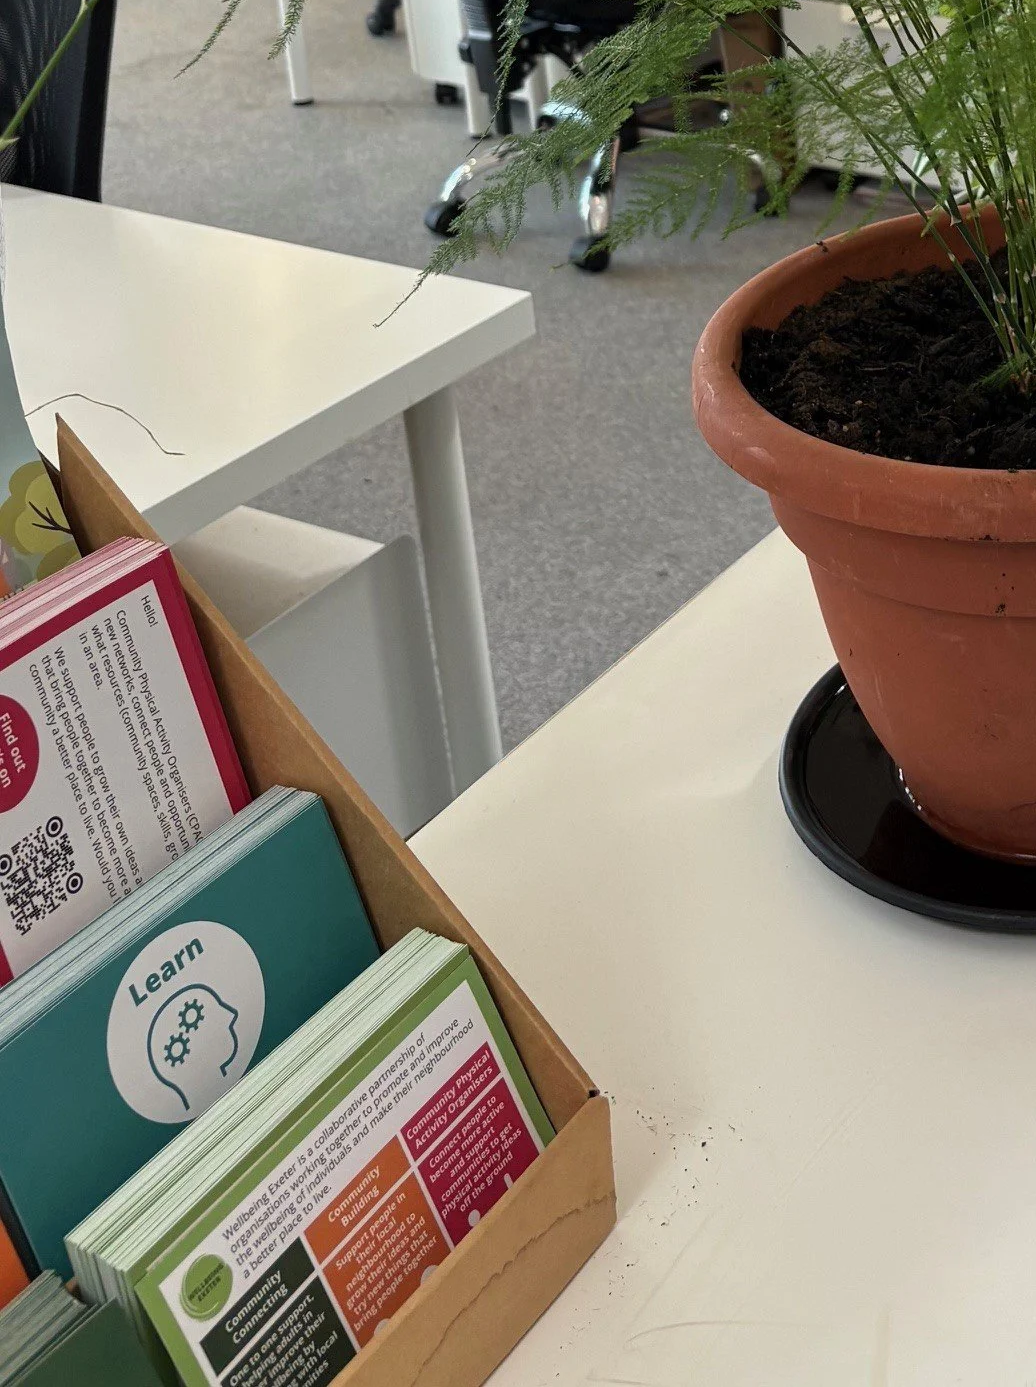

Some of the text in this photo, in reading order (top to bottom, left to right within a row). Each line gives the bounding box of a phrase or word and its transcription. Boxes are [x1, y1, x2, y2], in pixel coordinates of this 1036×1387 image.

[140, 594, 159, 628] Hello!
[41, 654, 56, 681] that
[54, 646, 66, 667] We
[78, 631, 103, 691] in an area.
[29, 663, 57, 726] community
[50, 678, 67, 712] bring
[60, 667, 83, 713] support
[103, 617, 118, 641] new
[112, 642, 135, 696] networks,
[131, 695, 152, 740] connect
[143, 739, 165, 777] people
[159, 777, 175, 799] and
[116, 609, 144, 672] Community
[137, 672, 161, 717] Physical
[152, 717, 172, 756] Activity
[167, 755, 192, 814] Organisers
[0, 712, 26, 773] Find out
[51, 727, 60, 736] a
[55, 734, 73, 770] better
[58, 710, 80, 750] people
[74, 712, 96, 752] people
[91, 624, 107, 654] what
[101, 653, 126, 708] resources
[118, 706, 148, 771] (community
[142, 771, 161, 813] spaces,
[156, 811, 172, 843] skills,
[75, 749, 98, 796] together
[90, 750, 100, 765] to
[92, 764, 111, 793] grow
[64, 771, 83, 803] place
[78, 801, 88, 816] to
[91, 797, 101, 811] to
[105, 793, 121, 820] their
[83, 814, 95, 840] live.
[96, 809, 118, 857] become
[115, 821, 129, 847] own
[91, 837, 112, 876] Would
[112, 856, 129, 888] more
[124, 844, 140, 877] ideas
[102, 875, 118, 899] you
[128, 938, 204, 1007] Learn
[406, 1049, 490, 1140] Community Physical
[415, 1065, 493, 1150] Activity Organisers
[222, 1031, 425, 1241] Wellbeing Exeter is a collaborative partnership of
[230, 1018, 459, 1254] organisations working together to promote and improve
[235, 1018, 474, 1267] the wellbeing of individuals and make their neighbourhood
[429, 1096, 497, 1169] Connect people to
[429, 1101, 505, 1184] become more active
[449, 1126, 495, 1178] and support
[441, 1122, 513, 1202] communities to get
[441, 1128, 522, 1220] physical activity ideas
[459, 1150, 514, 1212] off the ground
[328, 1165, 380, 1223] Community
[340, 1185, 380, 1227] Building
[243, 1185, 332, 1280] a better place to live.
[335, 1192, 406, 1271] Support people in
[345, 1212, 416, 1292] neighbourhood to
[353, 1216, 397, 1264] their local
[187, 1262, 224, 1302] WELLBEING
[346, 1215, 426, 1311] grow their ideas and
[353, 1230, 428, 1316] try new things that
[353, 1235, 437, 1332] bring people together
[197, 1275, 222, 1303] EXETER
[225, 1270, 281, 1333] Community
[232, 1283, 289, 1344] Connecting
[229, 1364, 250, 1387] One
[249, 1352, 261, 1366] to
[260, 1332, 278, 1354] one
[277, 1294, 315, 1335] support,
[267, 1311, 325, 1379] improve their
[276, 1321, 303, 1354] adults
[302, 1310, 313, 1324] in
[296, 1330, 338, 1380] with local
[302, 1340, 315, 1356] by
